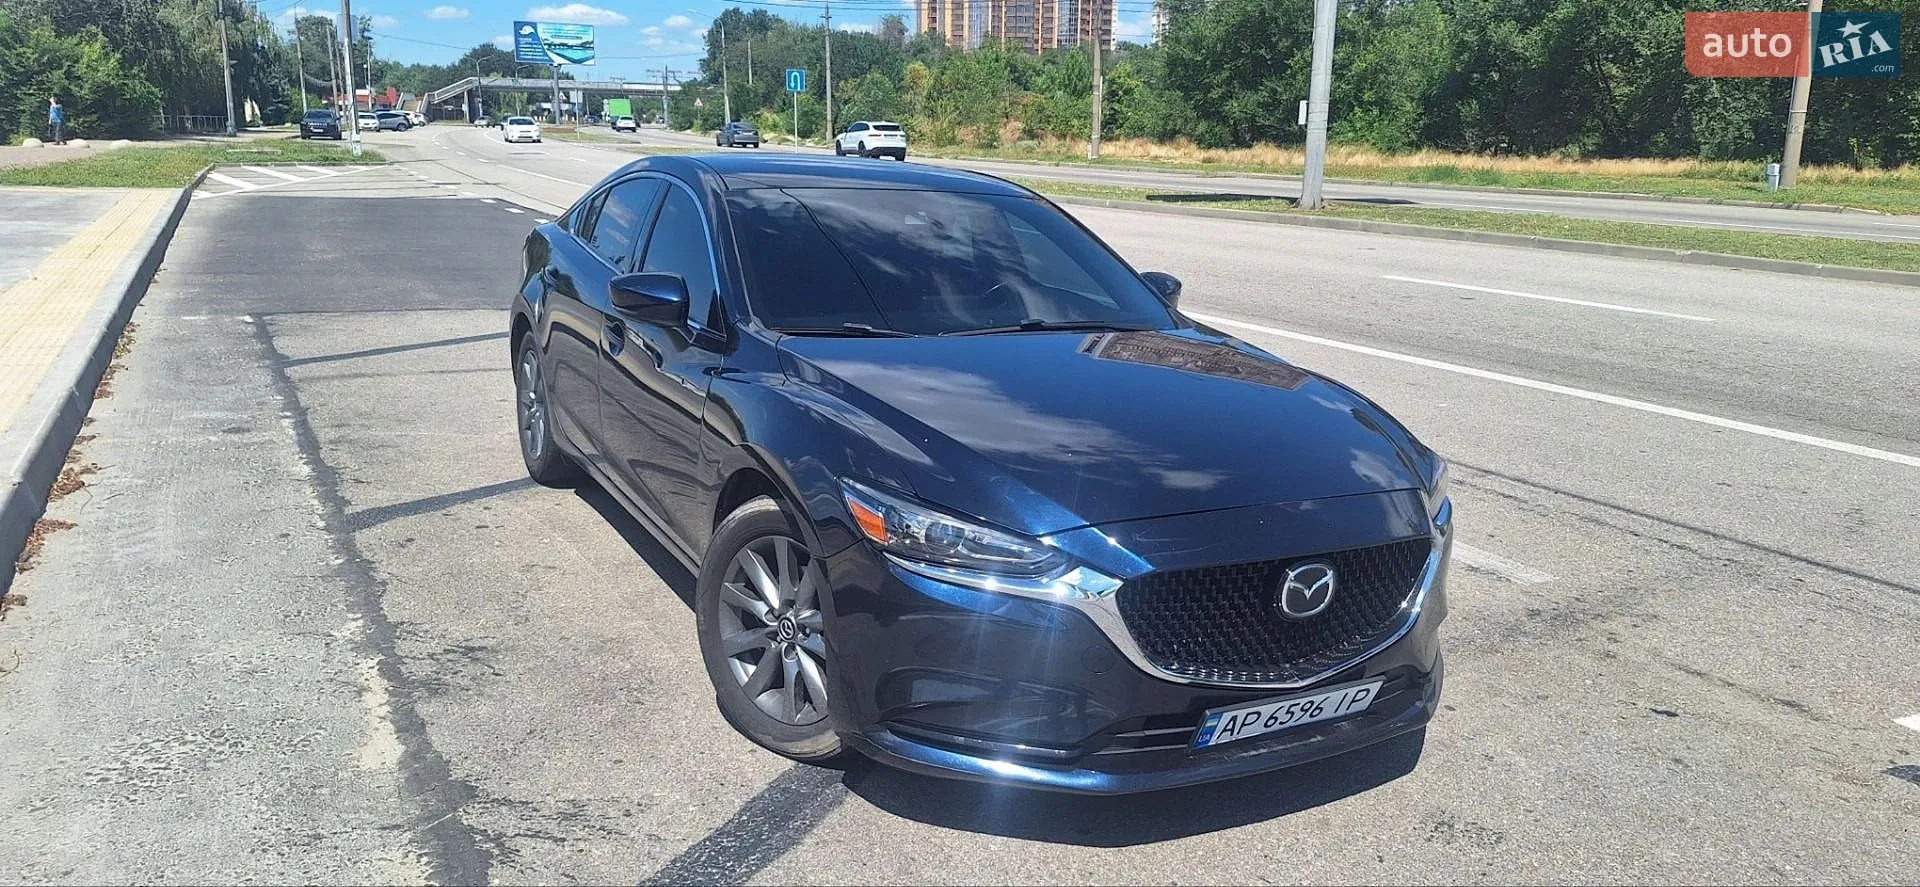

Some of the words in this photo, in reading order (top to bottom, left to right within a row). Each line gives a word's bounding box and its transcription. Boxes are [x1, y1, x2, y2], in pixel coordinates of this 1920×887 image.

[1216, 711, 1261, 740] AP
[1263, 696, 1331, 729] 6596
[1334, 687, 1371, 714] IP
